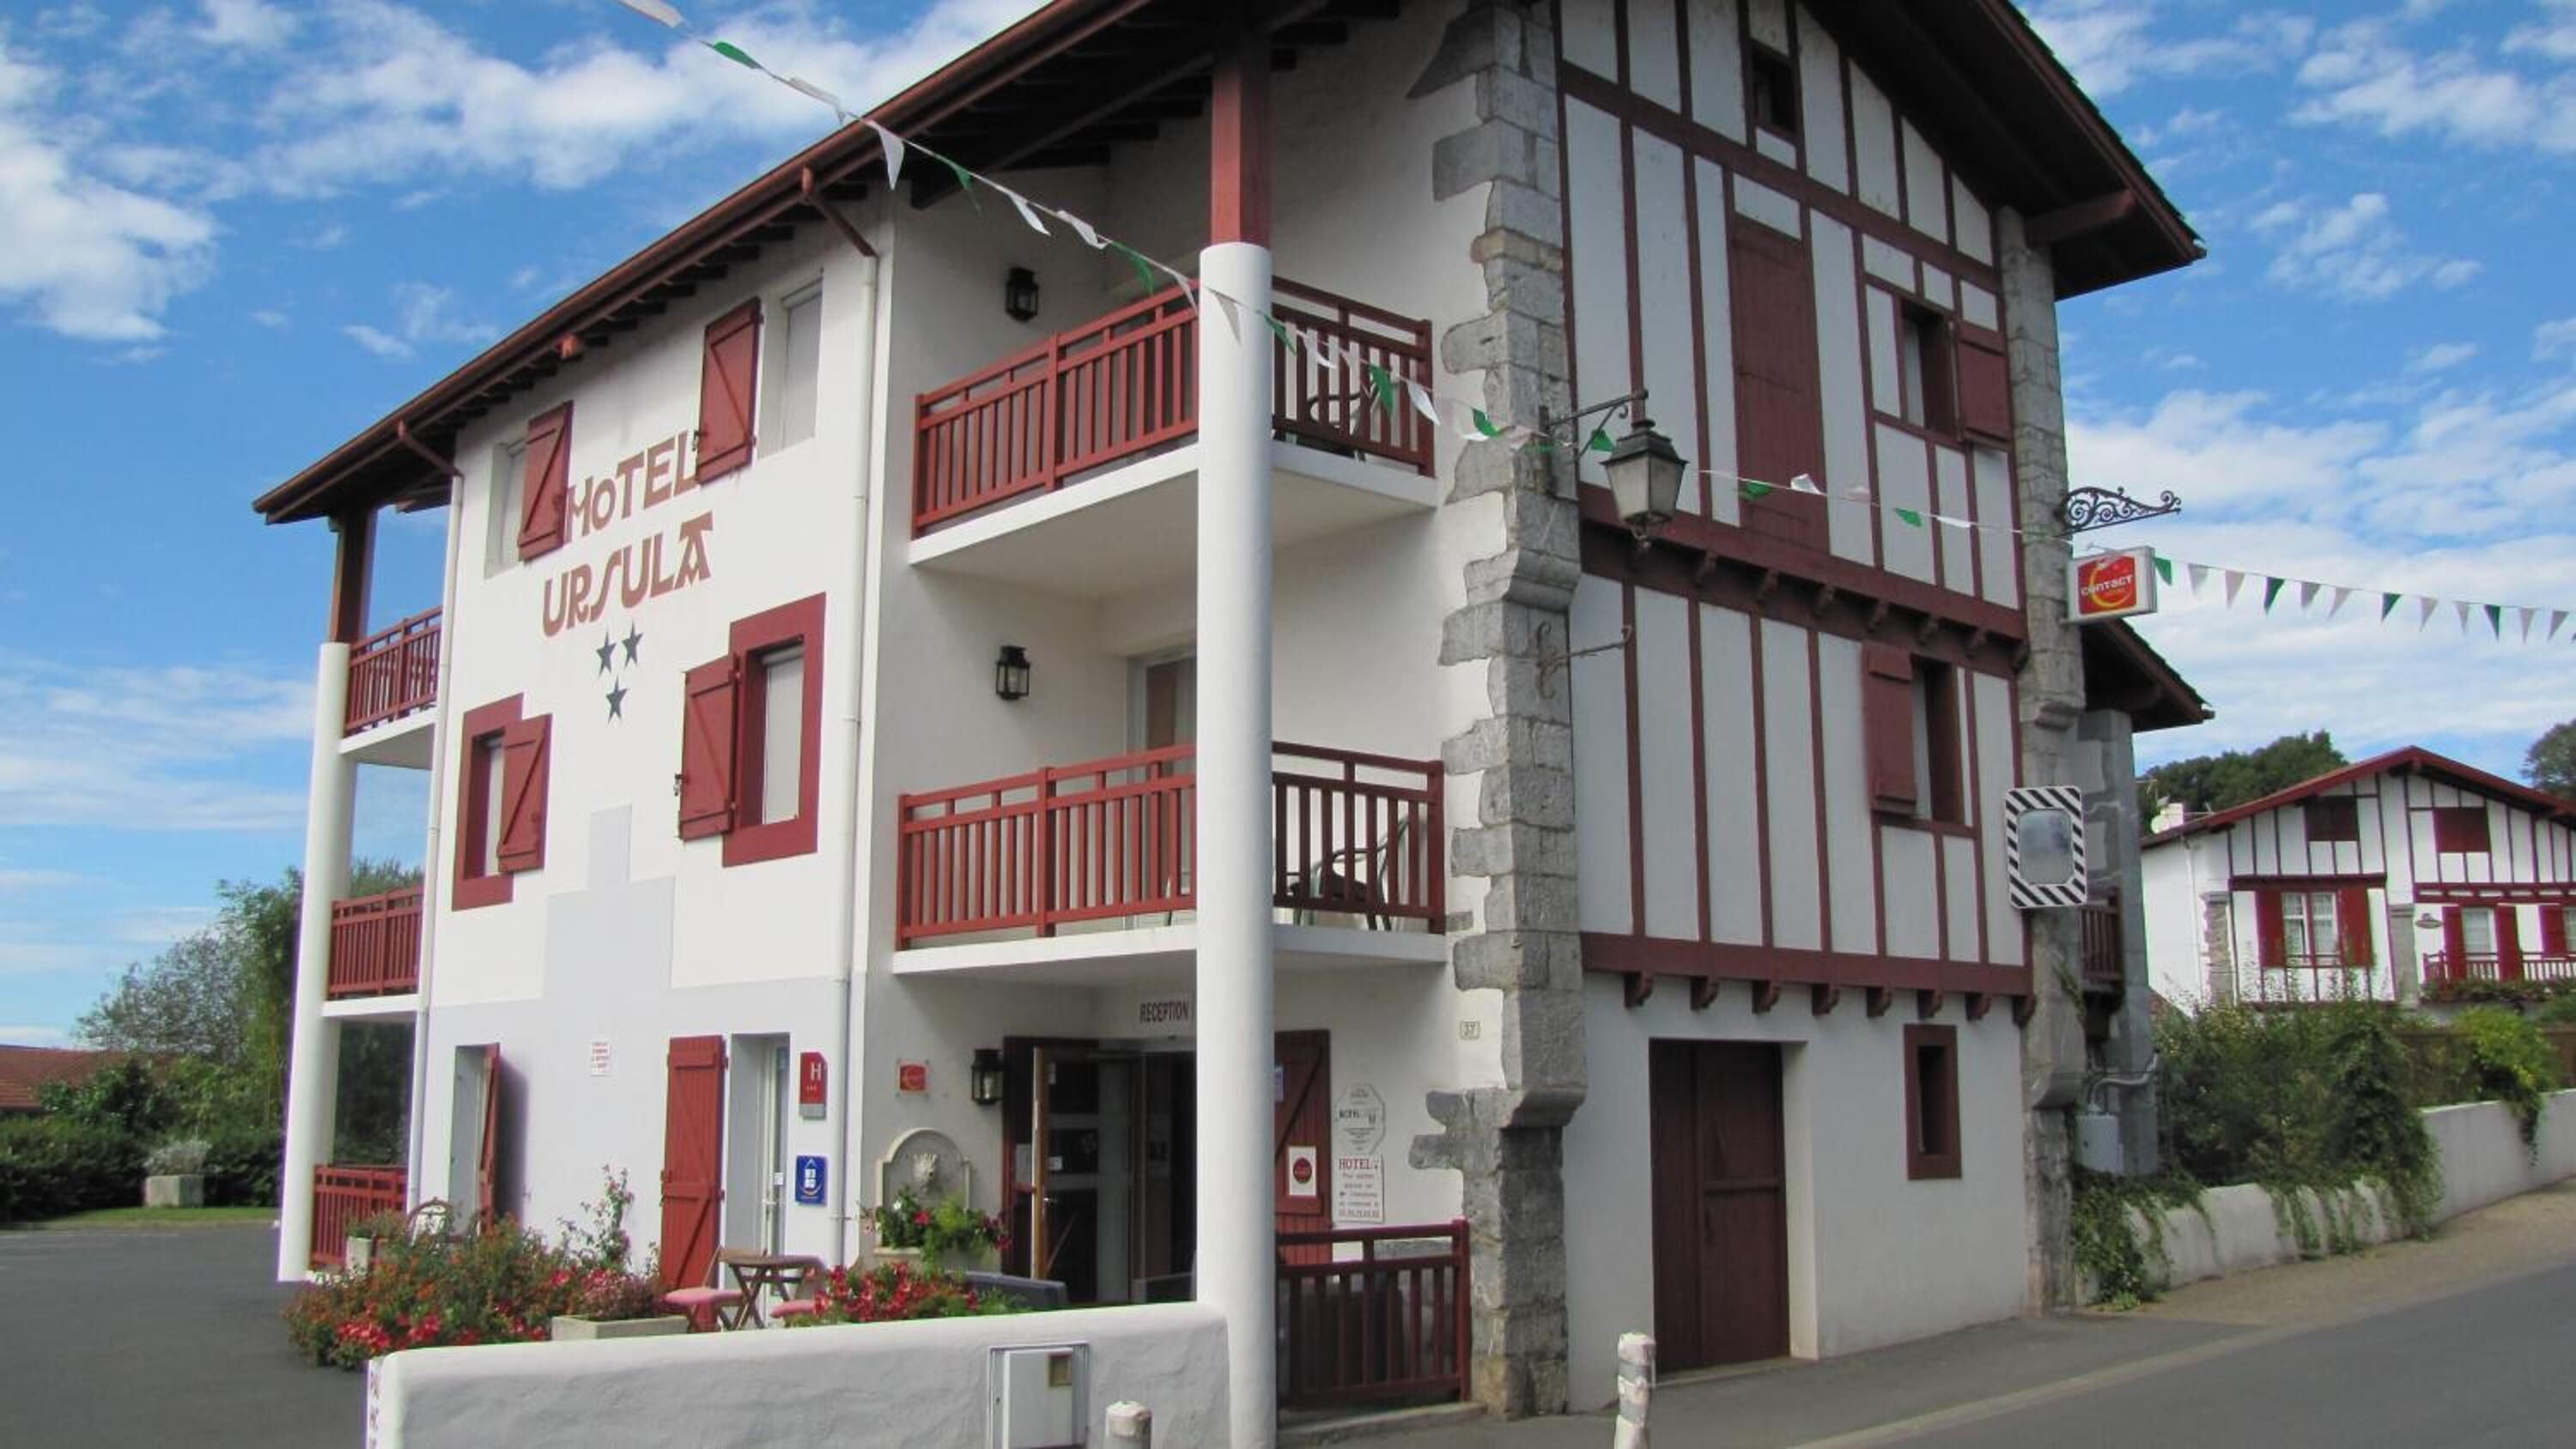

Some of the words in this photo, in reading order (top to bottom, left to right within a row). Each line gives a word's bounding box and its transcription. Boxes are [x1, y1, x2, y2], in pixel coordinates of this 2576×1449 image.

[564, 430, 700, 543] HOTEL
[543, 510, 714, 637] URSULA
[1139, 1002, 1188, 1023] RECEPTION
[1339, 1158, 1373, 1170] HOTEL
